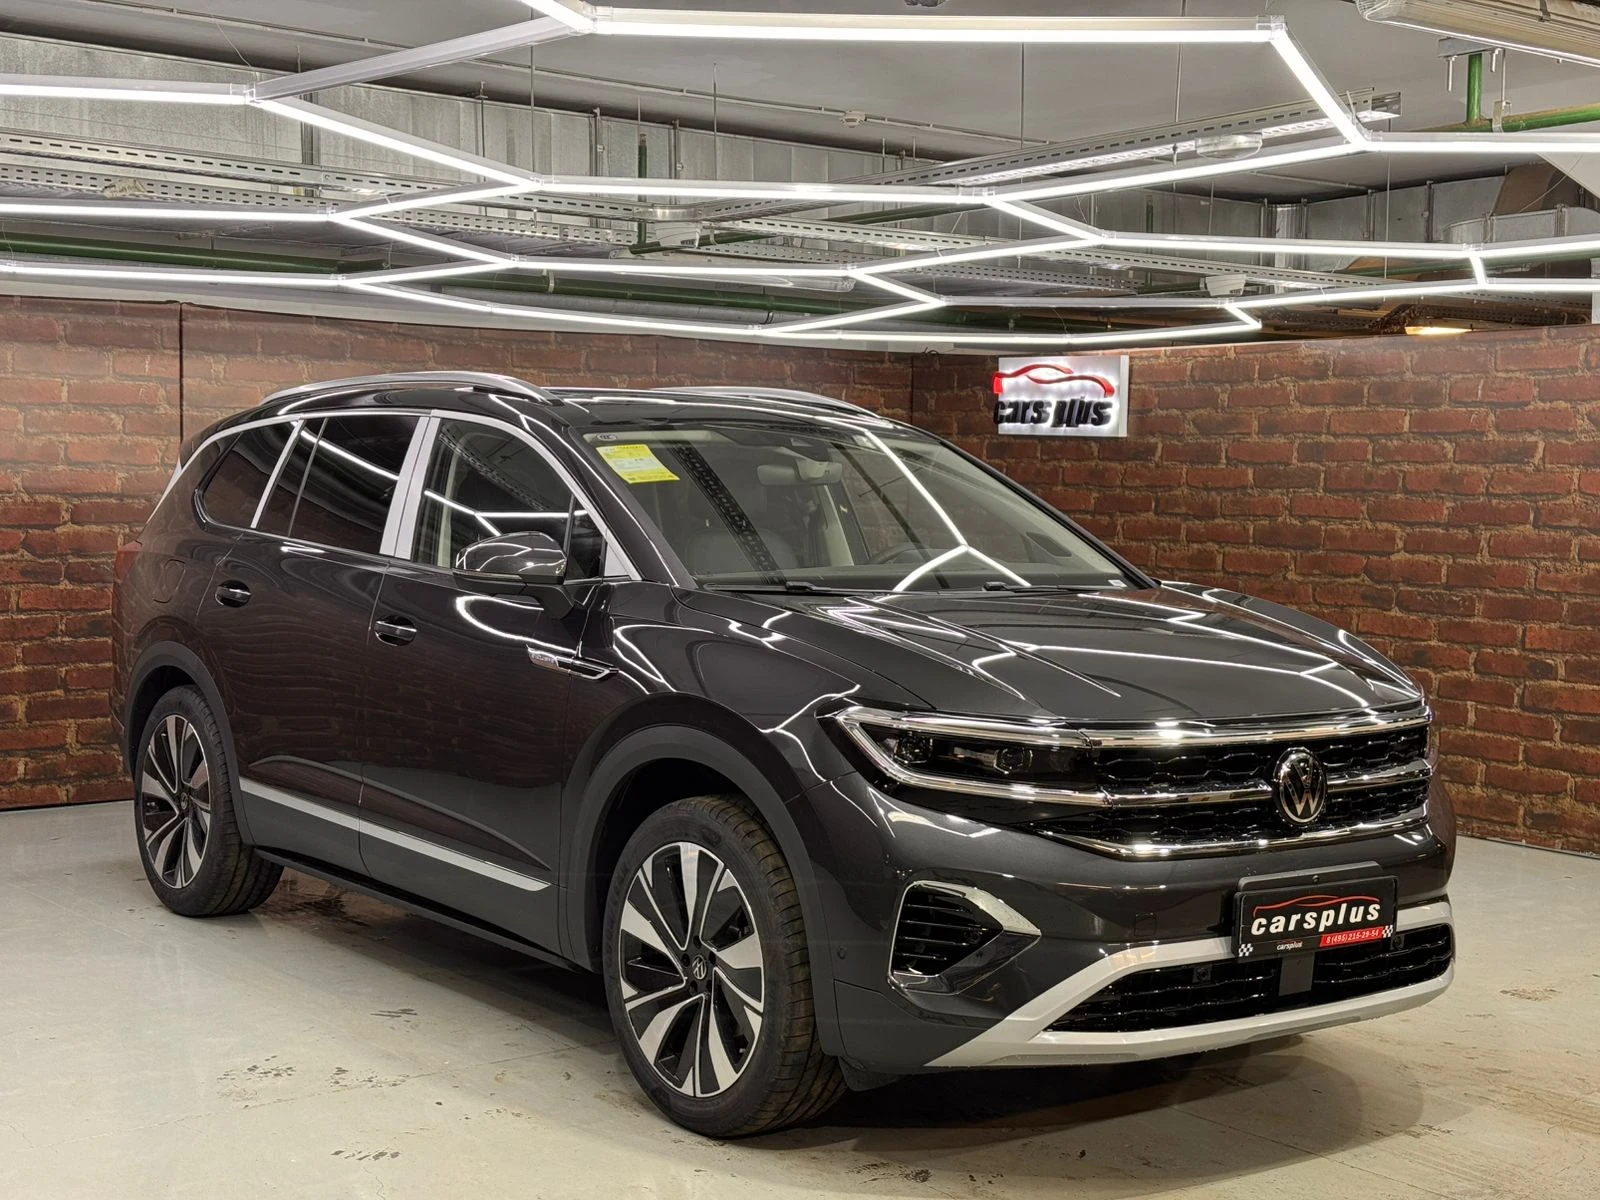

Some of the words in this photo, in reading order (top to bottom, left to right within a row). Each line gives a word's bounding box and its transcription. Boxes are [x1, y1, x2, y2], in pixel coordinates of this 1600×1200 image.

[993, 400, 1053, 425] cars
[1050, 398, 1113, 428] plus
[1251, 903, 1381, 936] carsplus
[1276, 941, 1303, 951] carsplus
